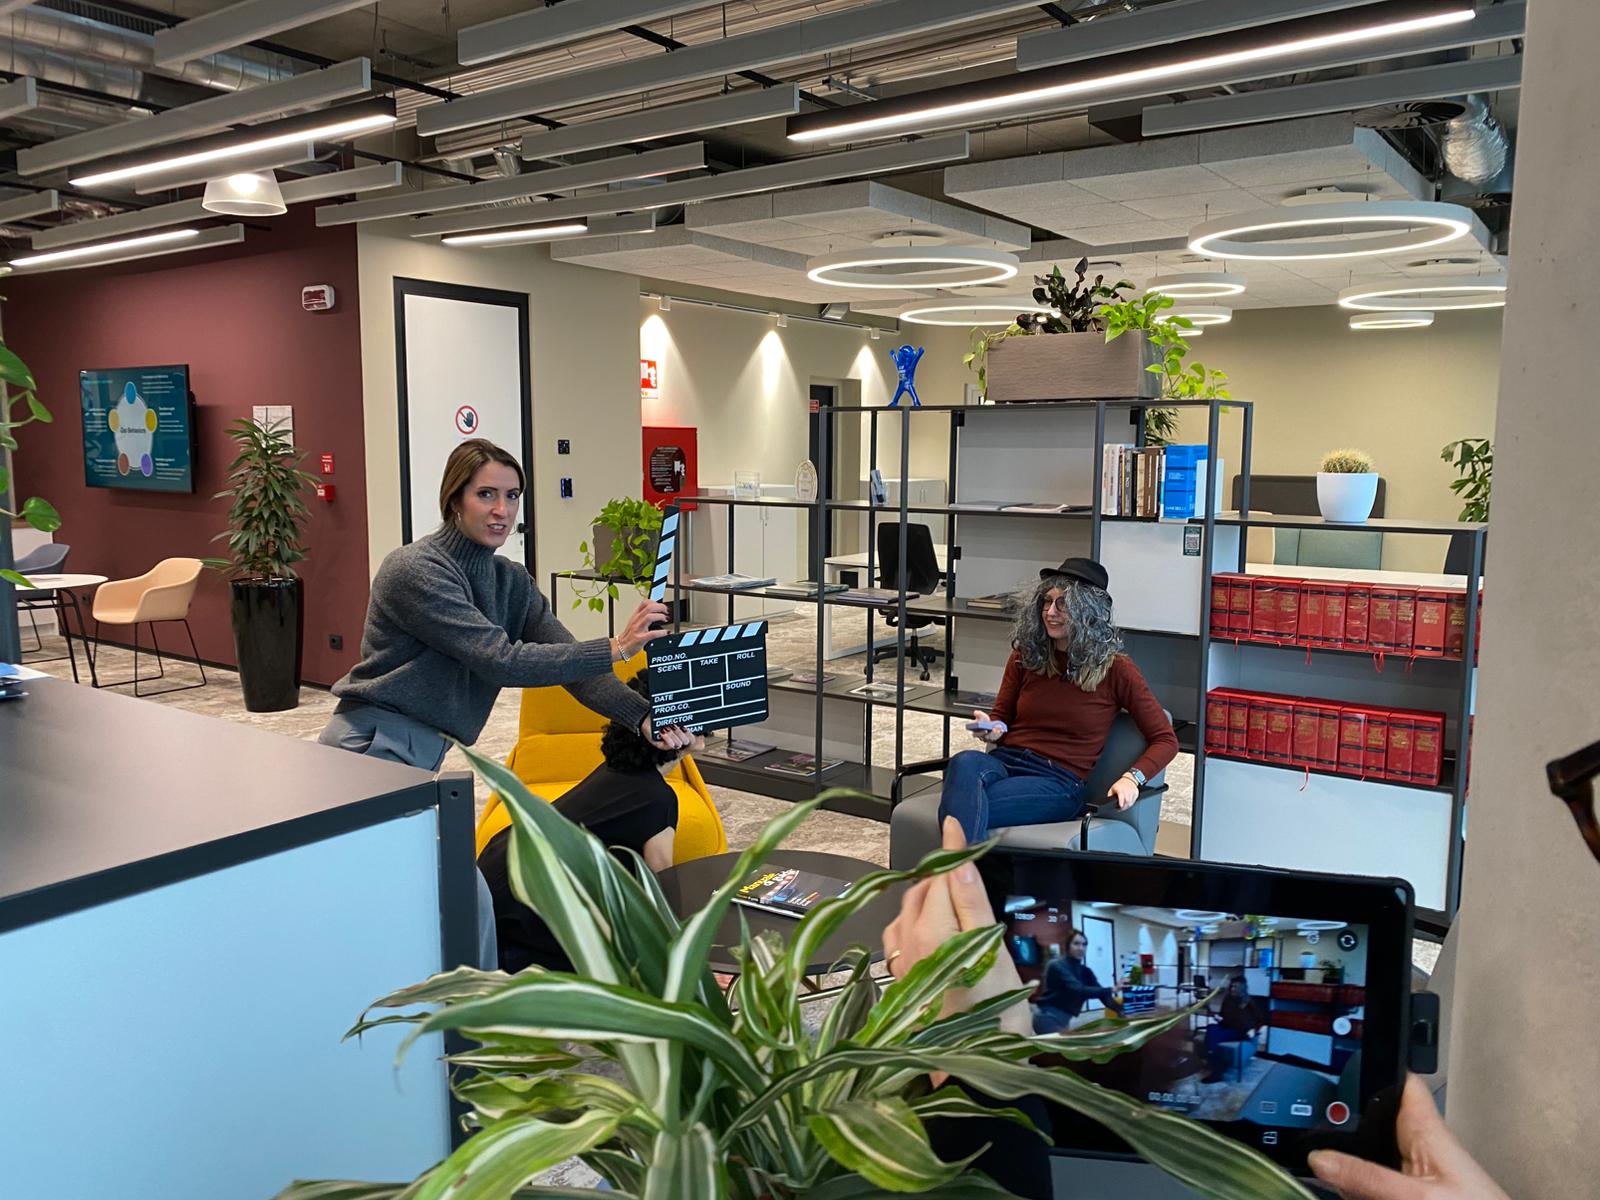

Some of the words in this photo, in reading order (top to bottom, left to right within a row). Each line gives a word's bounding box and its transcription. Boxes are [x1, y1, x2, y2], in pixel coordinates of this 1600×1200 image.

[736, 652, 755, 660] ROLL
[700, 658, 718, 666] TAKE
[657, 664, 682, 673] SCENE
[726, 680, 751, 690] SOUND
[654, 694, 673, 703] DATE
[656, 715, 693, 727] DIRECTOR
